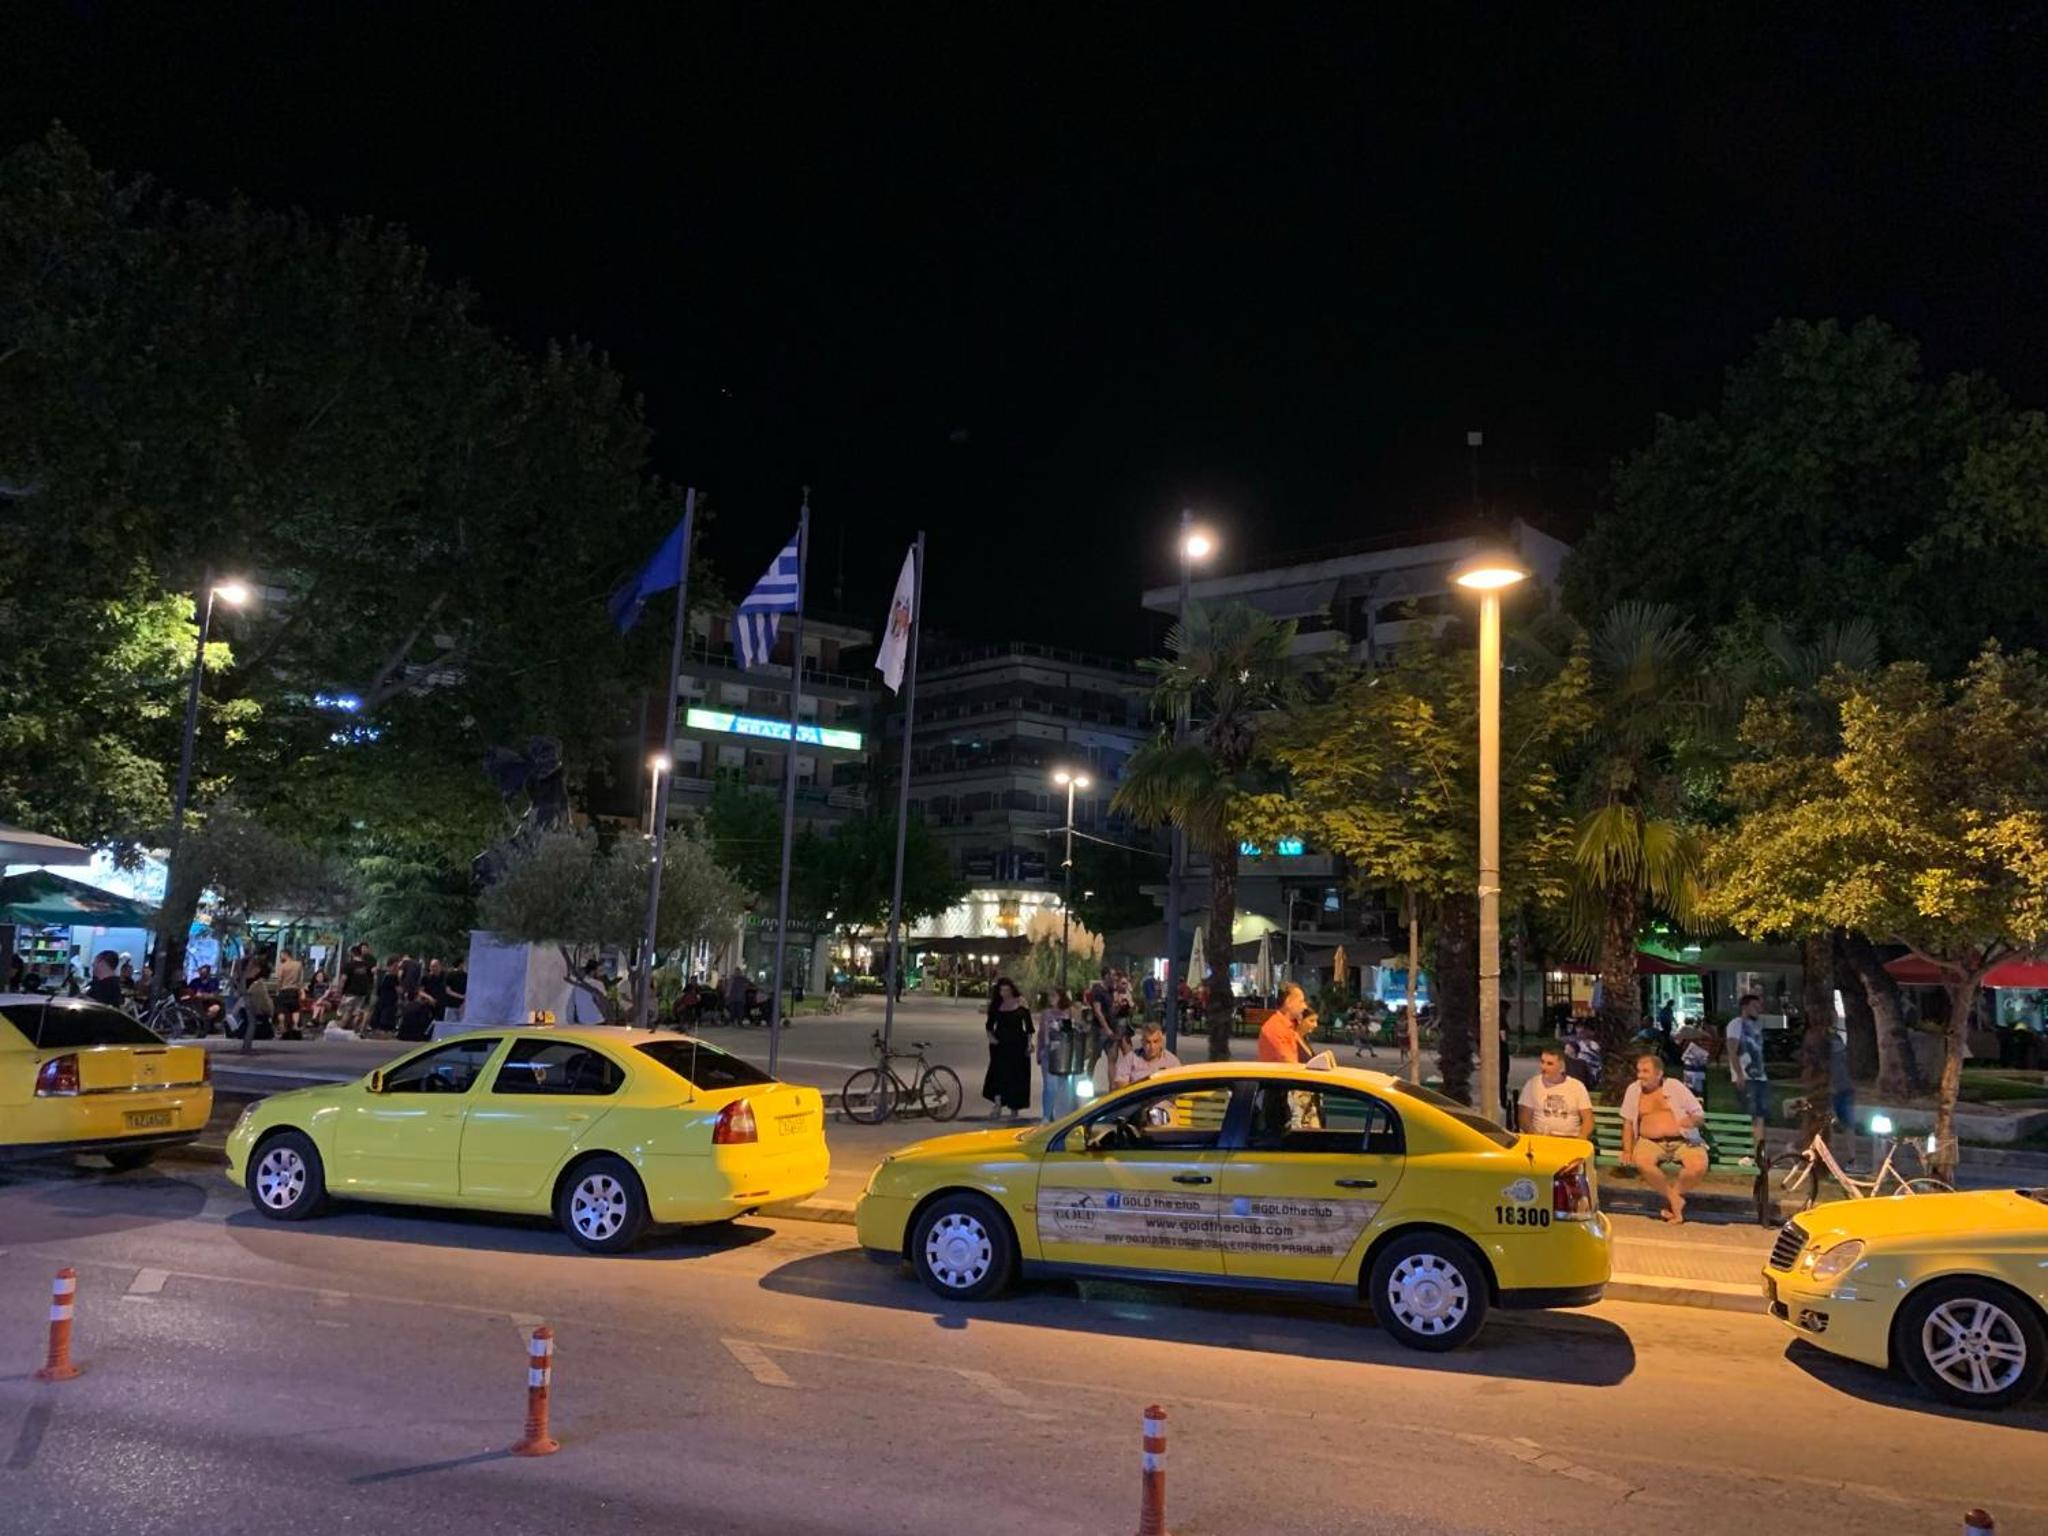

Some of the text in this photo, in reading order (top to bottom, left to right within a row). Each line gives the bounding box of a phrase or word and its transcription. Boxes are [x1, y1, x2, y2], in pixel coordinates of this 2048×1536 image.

[1123, 1196, 1200, 1210] GOLD the club
[1495, 1205, 1550, 1227] 18300
[1145, 1218, 1294, 1236] www.goldtheclub.com
